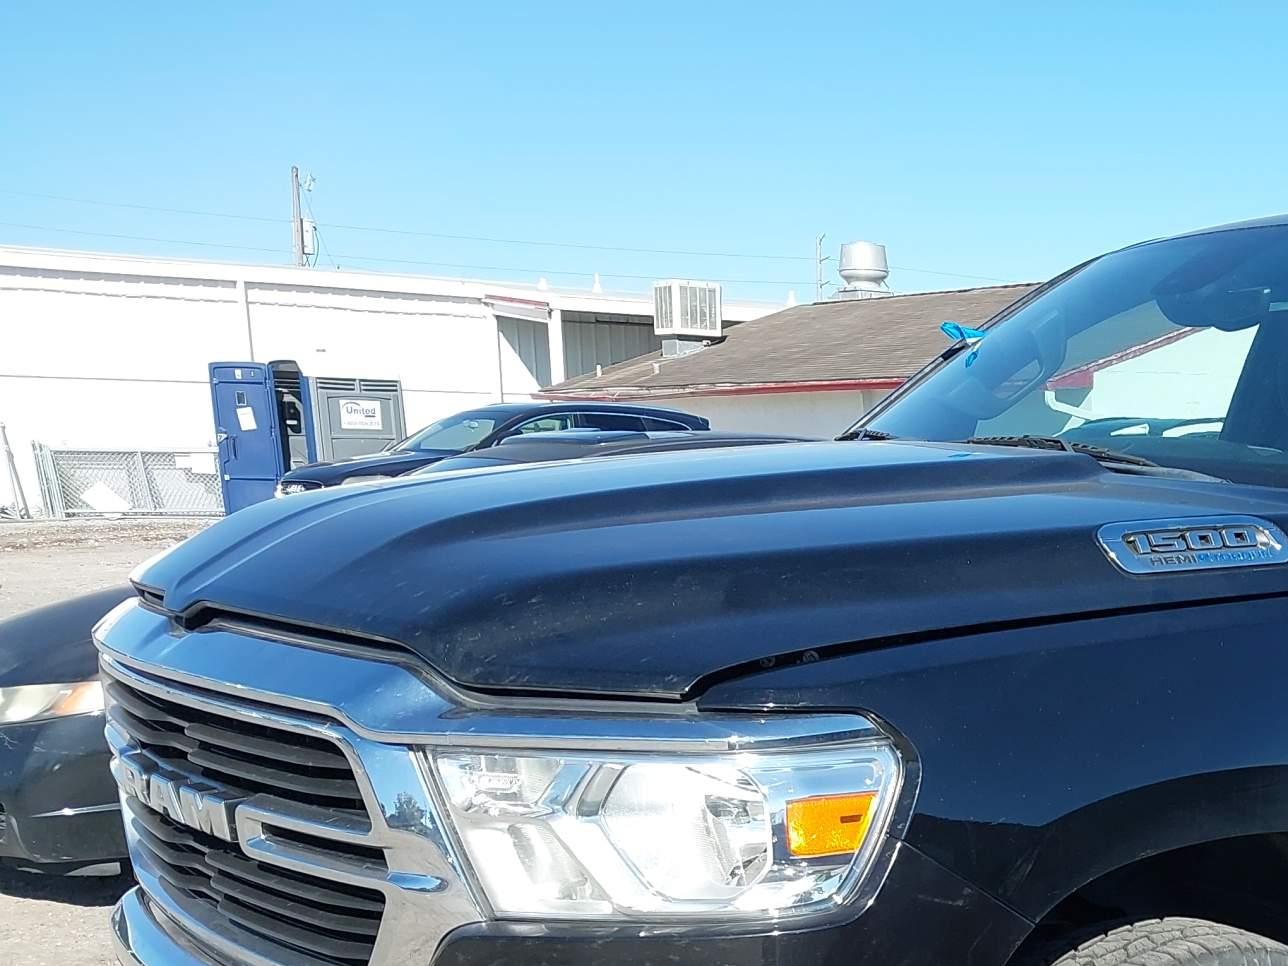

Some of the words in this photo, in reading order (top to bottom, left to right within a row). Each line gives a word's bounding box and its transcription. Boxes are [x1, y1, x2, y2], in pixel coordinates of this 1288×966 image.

[346, 406, 376, 415] United
[1121, 527, 1258, 554] 1500
[1151, 554, 1196, 566] HEMI
[119, 752, 232, 842] RAM
